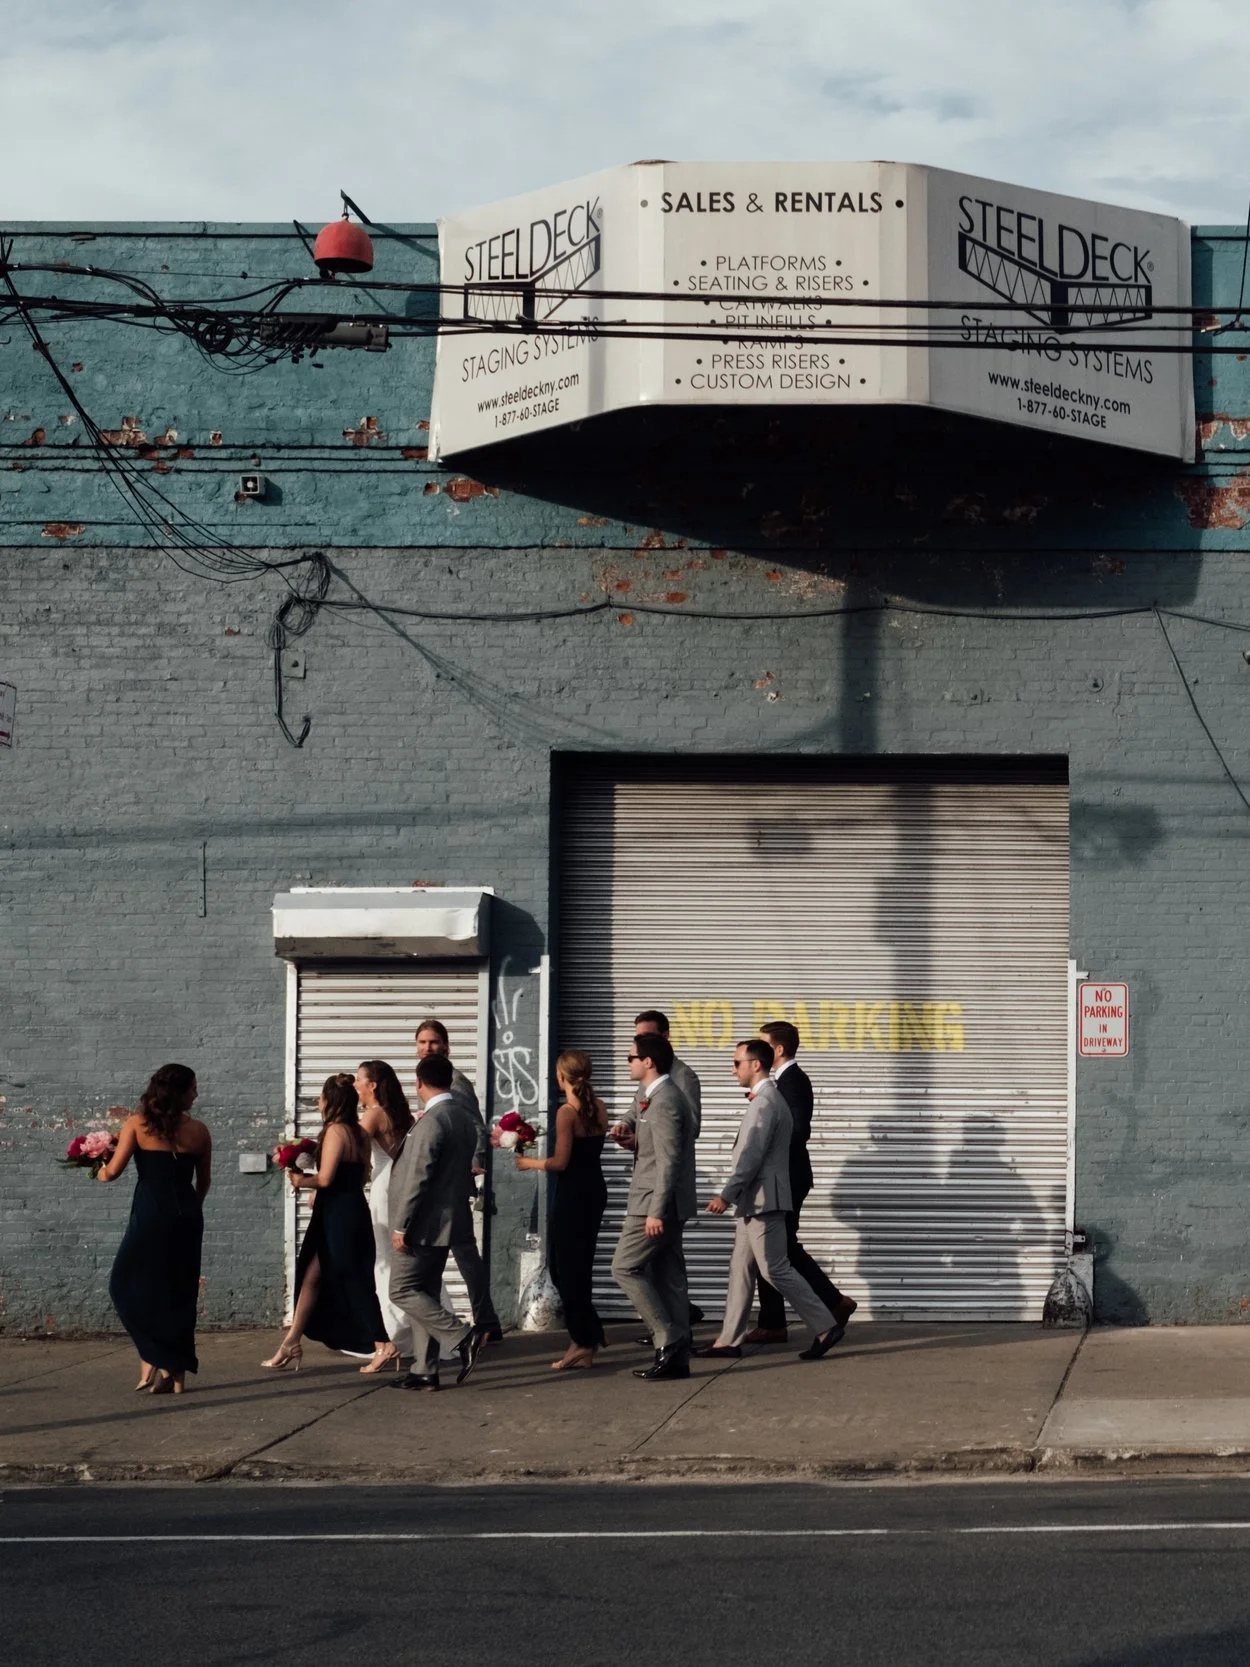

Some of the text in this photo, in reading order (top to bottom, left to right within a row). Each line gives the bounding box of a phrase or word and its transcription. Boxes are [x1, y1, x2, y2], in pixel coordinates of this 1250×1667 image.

[661, 192, 883, 213] SALES & RENTALS
[716, 255, 827, 271] PLATFORMS
[687, 275, 854, 291] SEATING & RISERS
[719, 295, 823, 311] CATWALKS
[725, 315, 816, 330] PIT INFILLS
[462, 315, 599, 383] STAGING SYSTEMS
[960, 315, 1154, 384] STAGING SYSTEMS
[711, 354, 830, 370] PRESS RISERS
[690, 373, 851, 389] CUSTOM DESIGN
[477, 373, 580, 413] www.steeldeckny.com
[988, 371, 1131, 415] www.steeldeckny.com
[494, 398, 560, 428] 1-877-60-STAGE
[1017, 397, 1107, 429] 1-877-60-STAGE
[1095, 990, 1112, 1002] NO
[1084, 1005, 1123, 1018] PARKING
[672, 999, 965, 1051] NO PARKING
[1099, 1023, 1108, 1033] IN
[1083, 1037, 1123, 1047] DRIVEWAY
